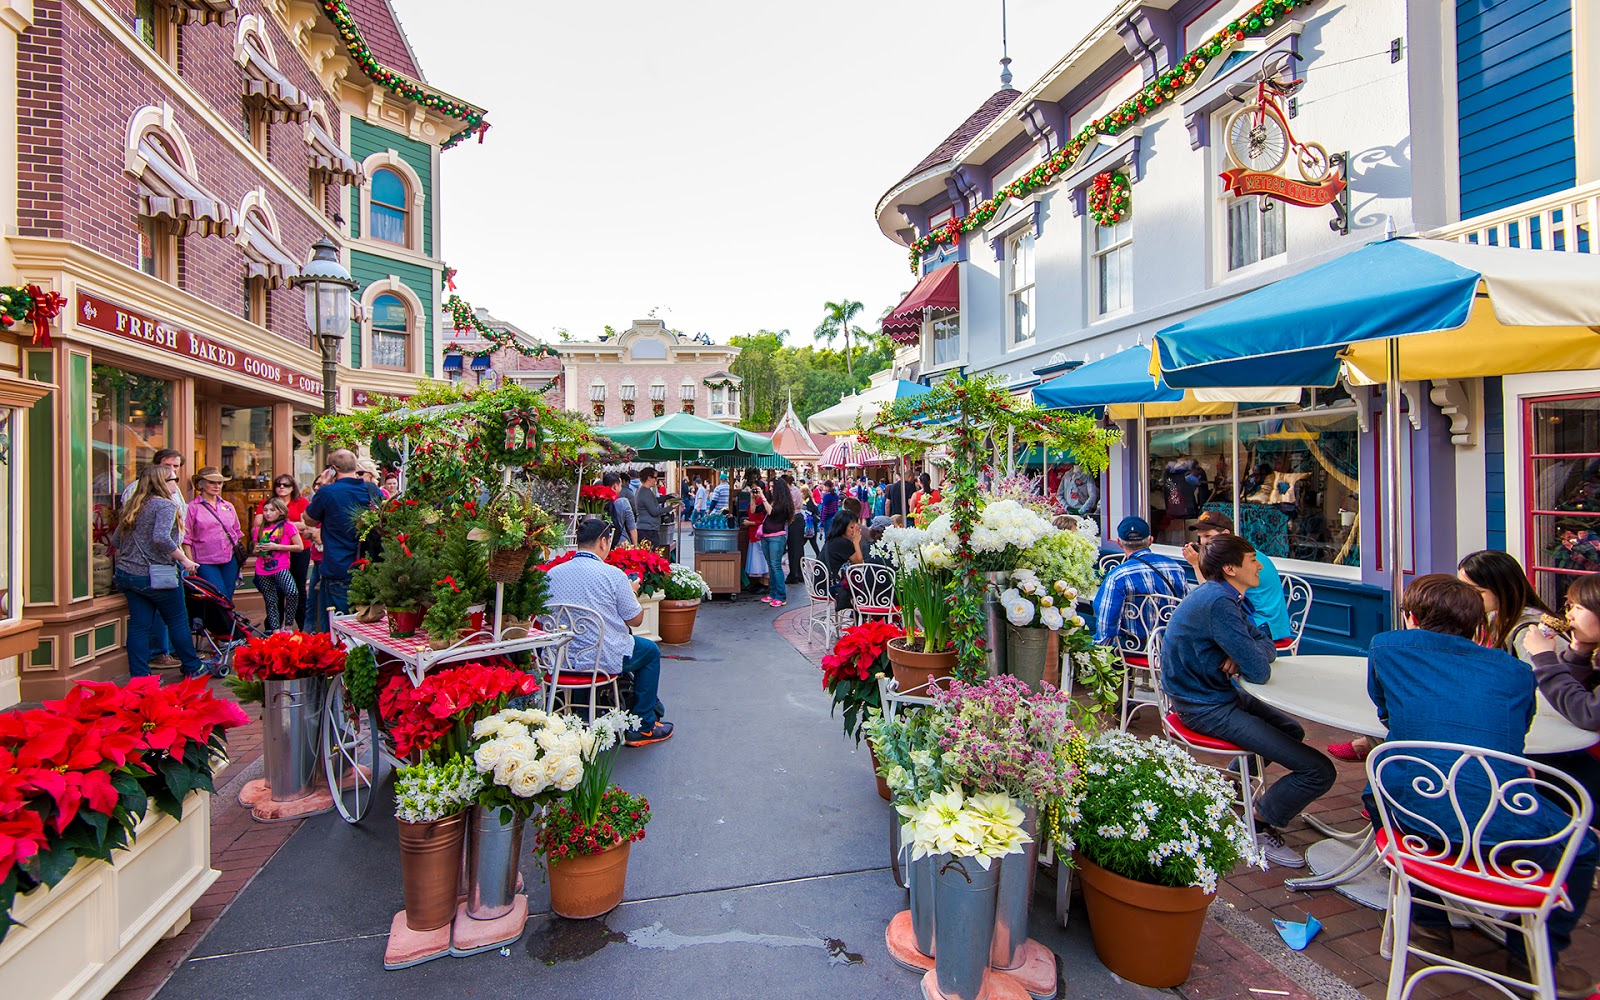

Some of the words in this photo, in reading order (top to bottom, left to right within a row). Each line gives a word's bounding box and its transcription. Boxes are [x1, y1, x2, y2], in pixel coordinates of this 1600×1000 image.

[1245, 176, 1286, 193] METEOR
[1288, 183, 1316, 201] CYCLE
[116, 311, 178, 349] FRESH
[190, 337, 236, 367] BAKED
[244, 357, 280, 382] GOODS
